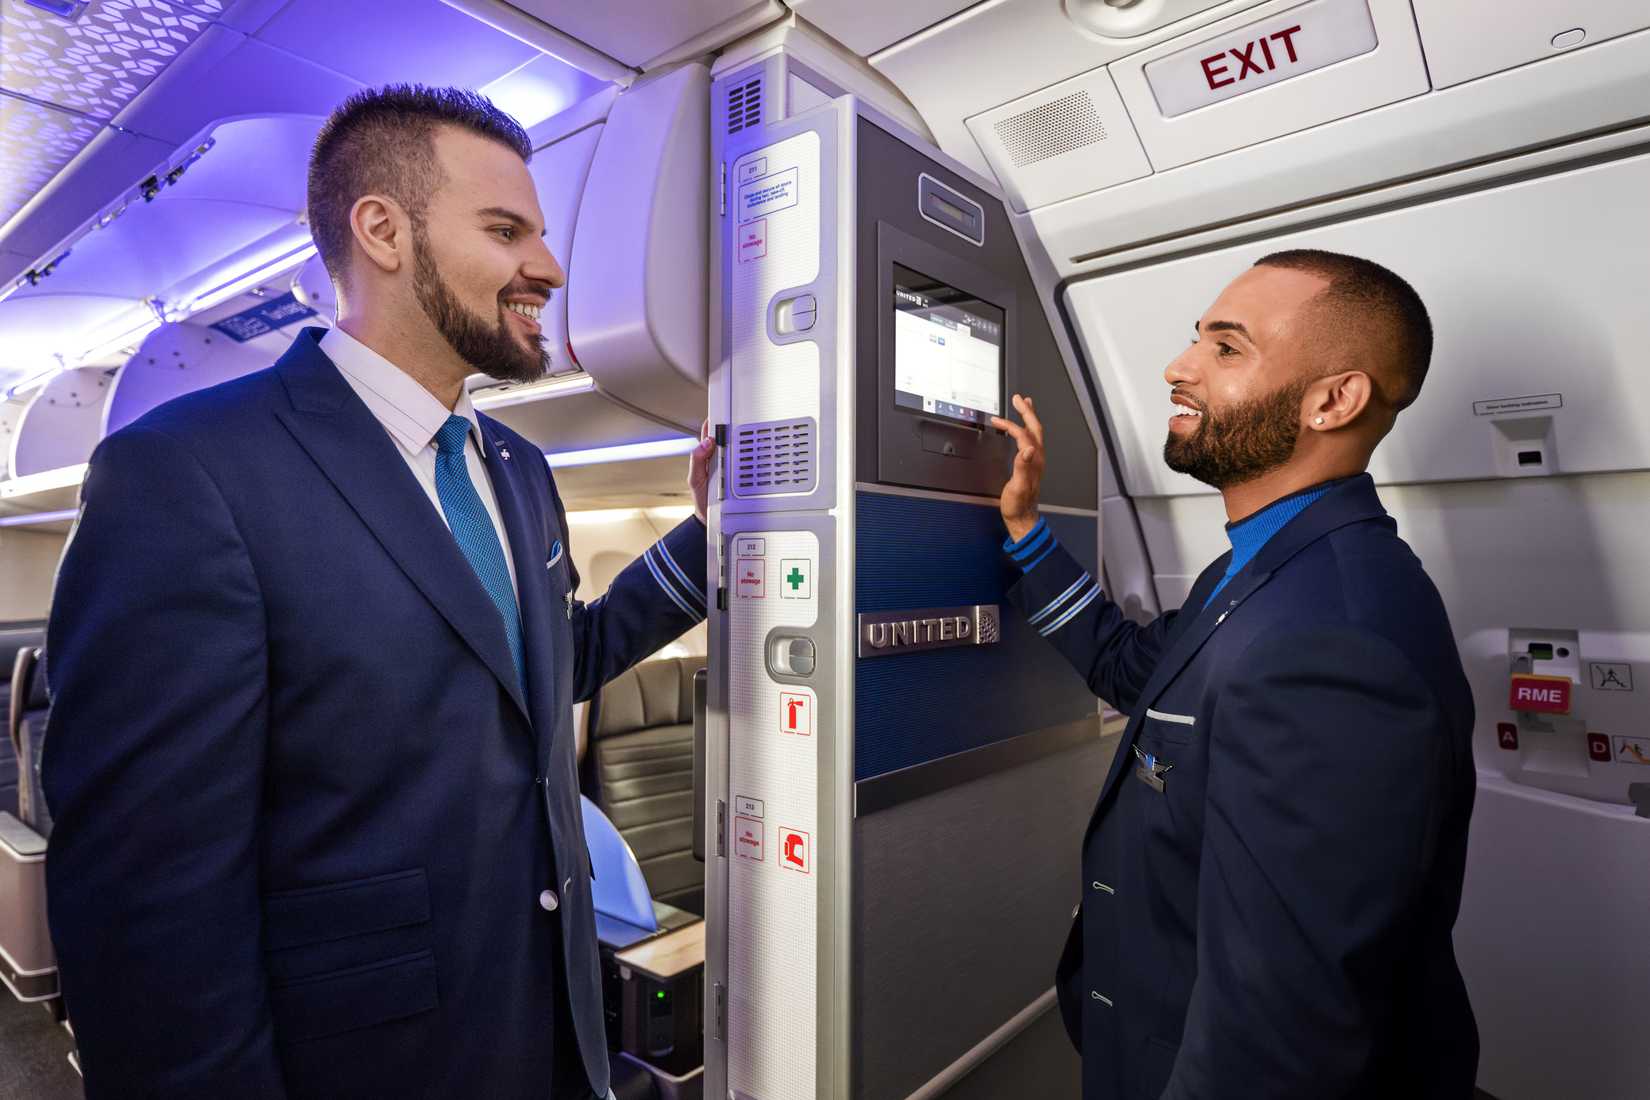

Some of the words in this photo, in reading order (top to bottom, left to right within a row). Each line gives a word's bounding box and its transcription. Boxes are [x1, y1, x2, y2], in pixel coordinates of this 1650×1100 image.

[1200, 24, 1301, 90] EXIT
[867, 616, 970, 649] UNITED
[1517, 687, 1562, 703] RME
[1502, 731, 1514, 742] A
[1593, 741, 1606, 753] D
